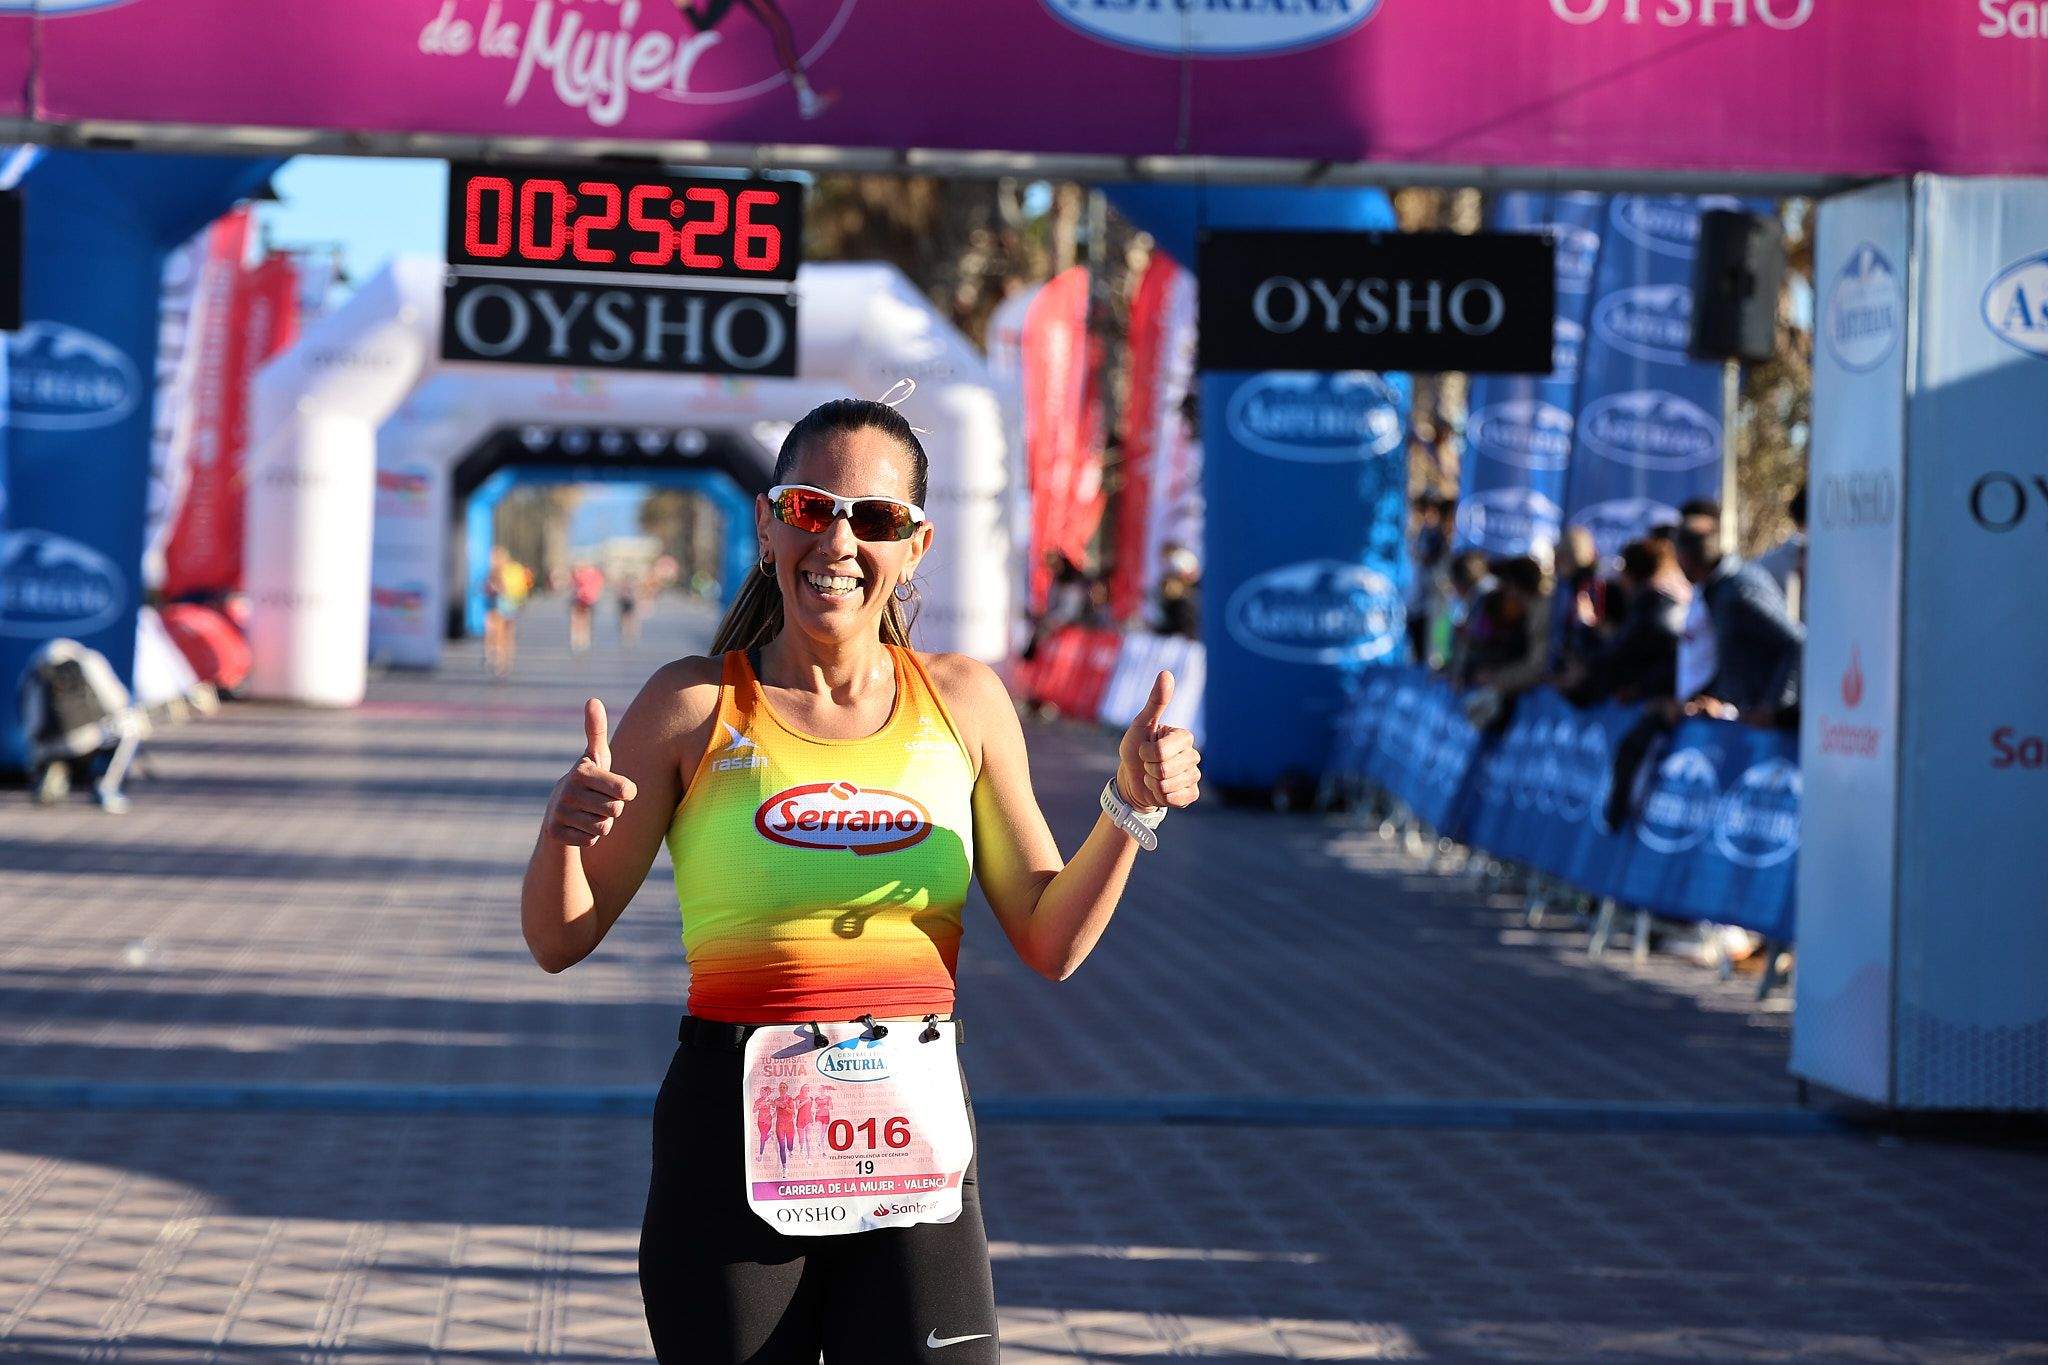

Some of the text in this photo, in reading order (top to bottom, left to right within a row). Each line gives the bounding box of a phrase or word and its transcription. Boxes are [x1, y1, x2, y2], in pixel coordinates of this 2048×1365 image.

[417, 0, 722, 127] de la Mujer
[464, 175, 781, 272] 00:25:26
[1251, 274, 1506, 336] OYSHO
[454, 283, 788, 370] OYSHO
[1989, 725, 2048, 770] Sa
[772, 800, 918, 832] Serrano
[763, 1065, 807, 1077] SUMA
[823, 1054, 888, 1072] ASTURIA
[828, 1116, 911, 1151] 016
[855, 1160, 875, 1175] 19
[778, 1183, 825, 1196] CARRERA
[828, 1182, 841, 1194] DE
[844, 1181, 857, 1193] LA
[860, 1180, 895, 1192] MUJER
[776, 1205, 846, 1223] OYSHO
